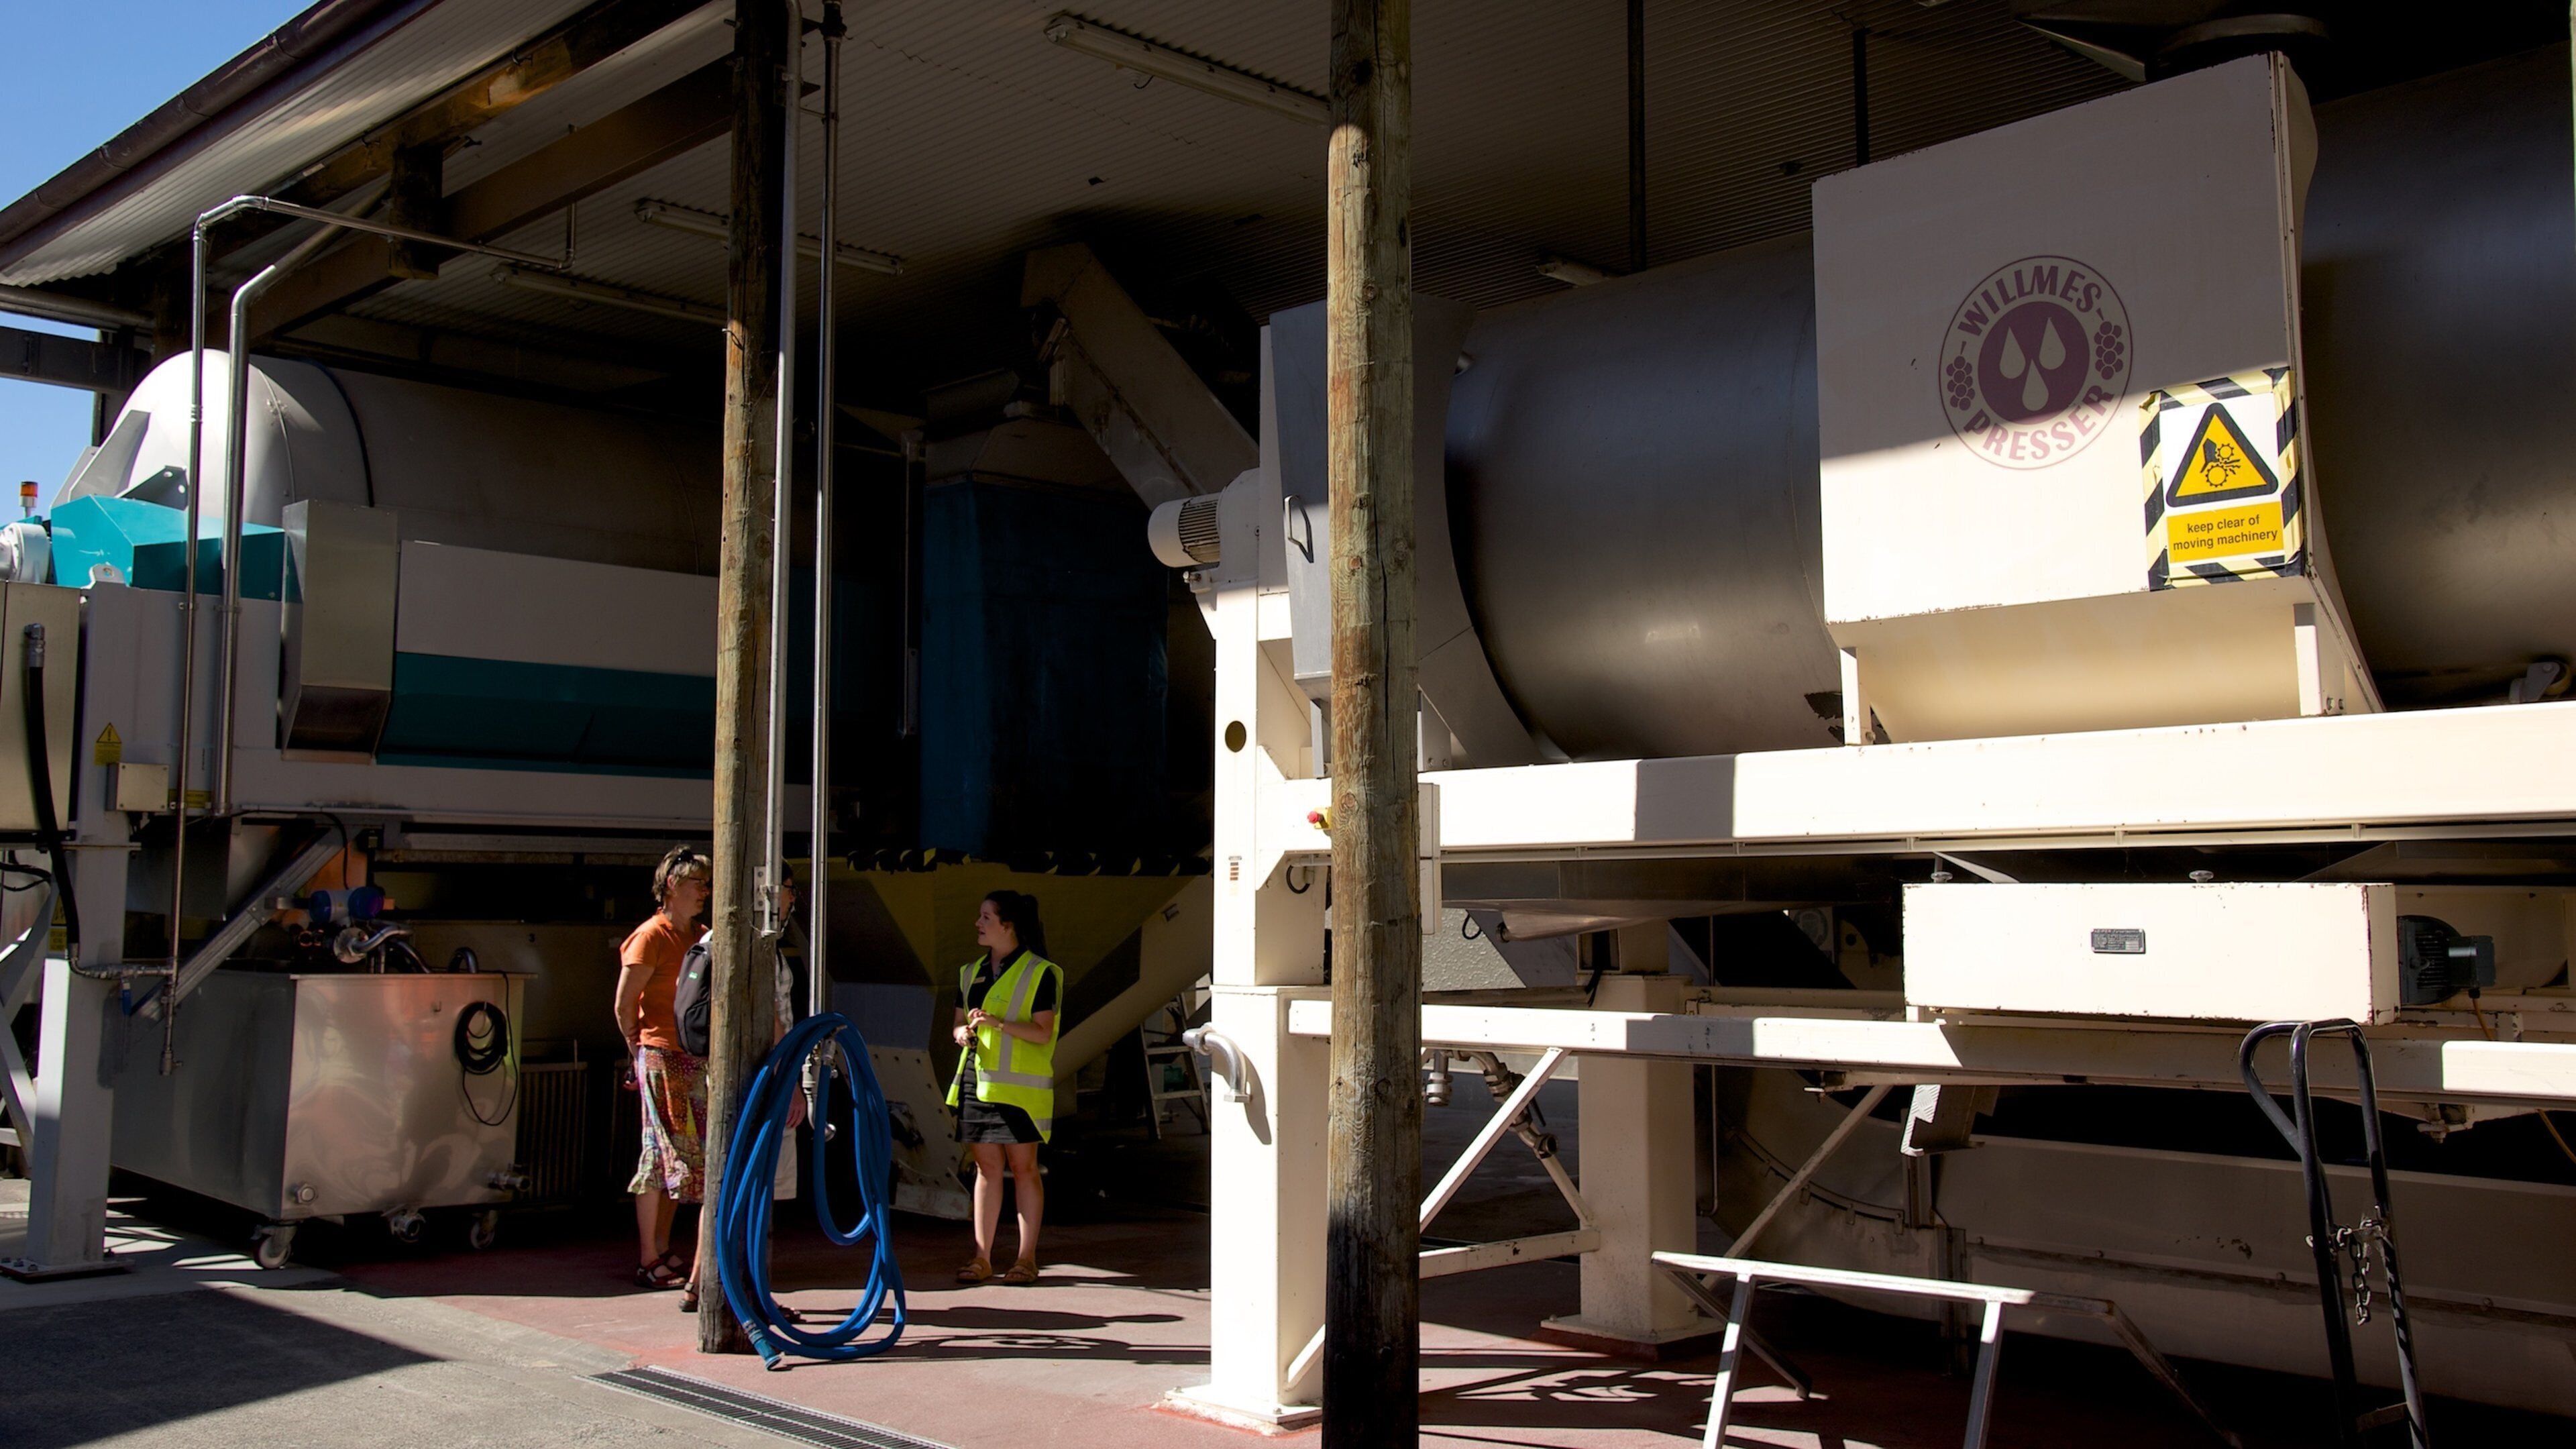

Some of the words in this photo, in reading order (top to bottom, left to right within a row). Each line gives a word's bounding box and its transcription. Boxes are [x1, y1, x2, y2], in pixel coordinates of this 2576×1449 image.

[1957, 265, 2102, 337] WILLMES
[1963, 384, 2115, 462] PRESSER
[2173, 537, 2214, 551] moving
[2217, 529, 2278, 545] machinery
[2187, 523, 2214, 534] keep
[2216, 518, 2245, 530] clear
[2248, 514, 2260, 526] of
